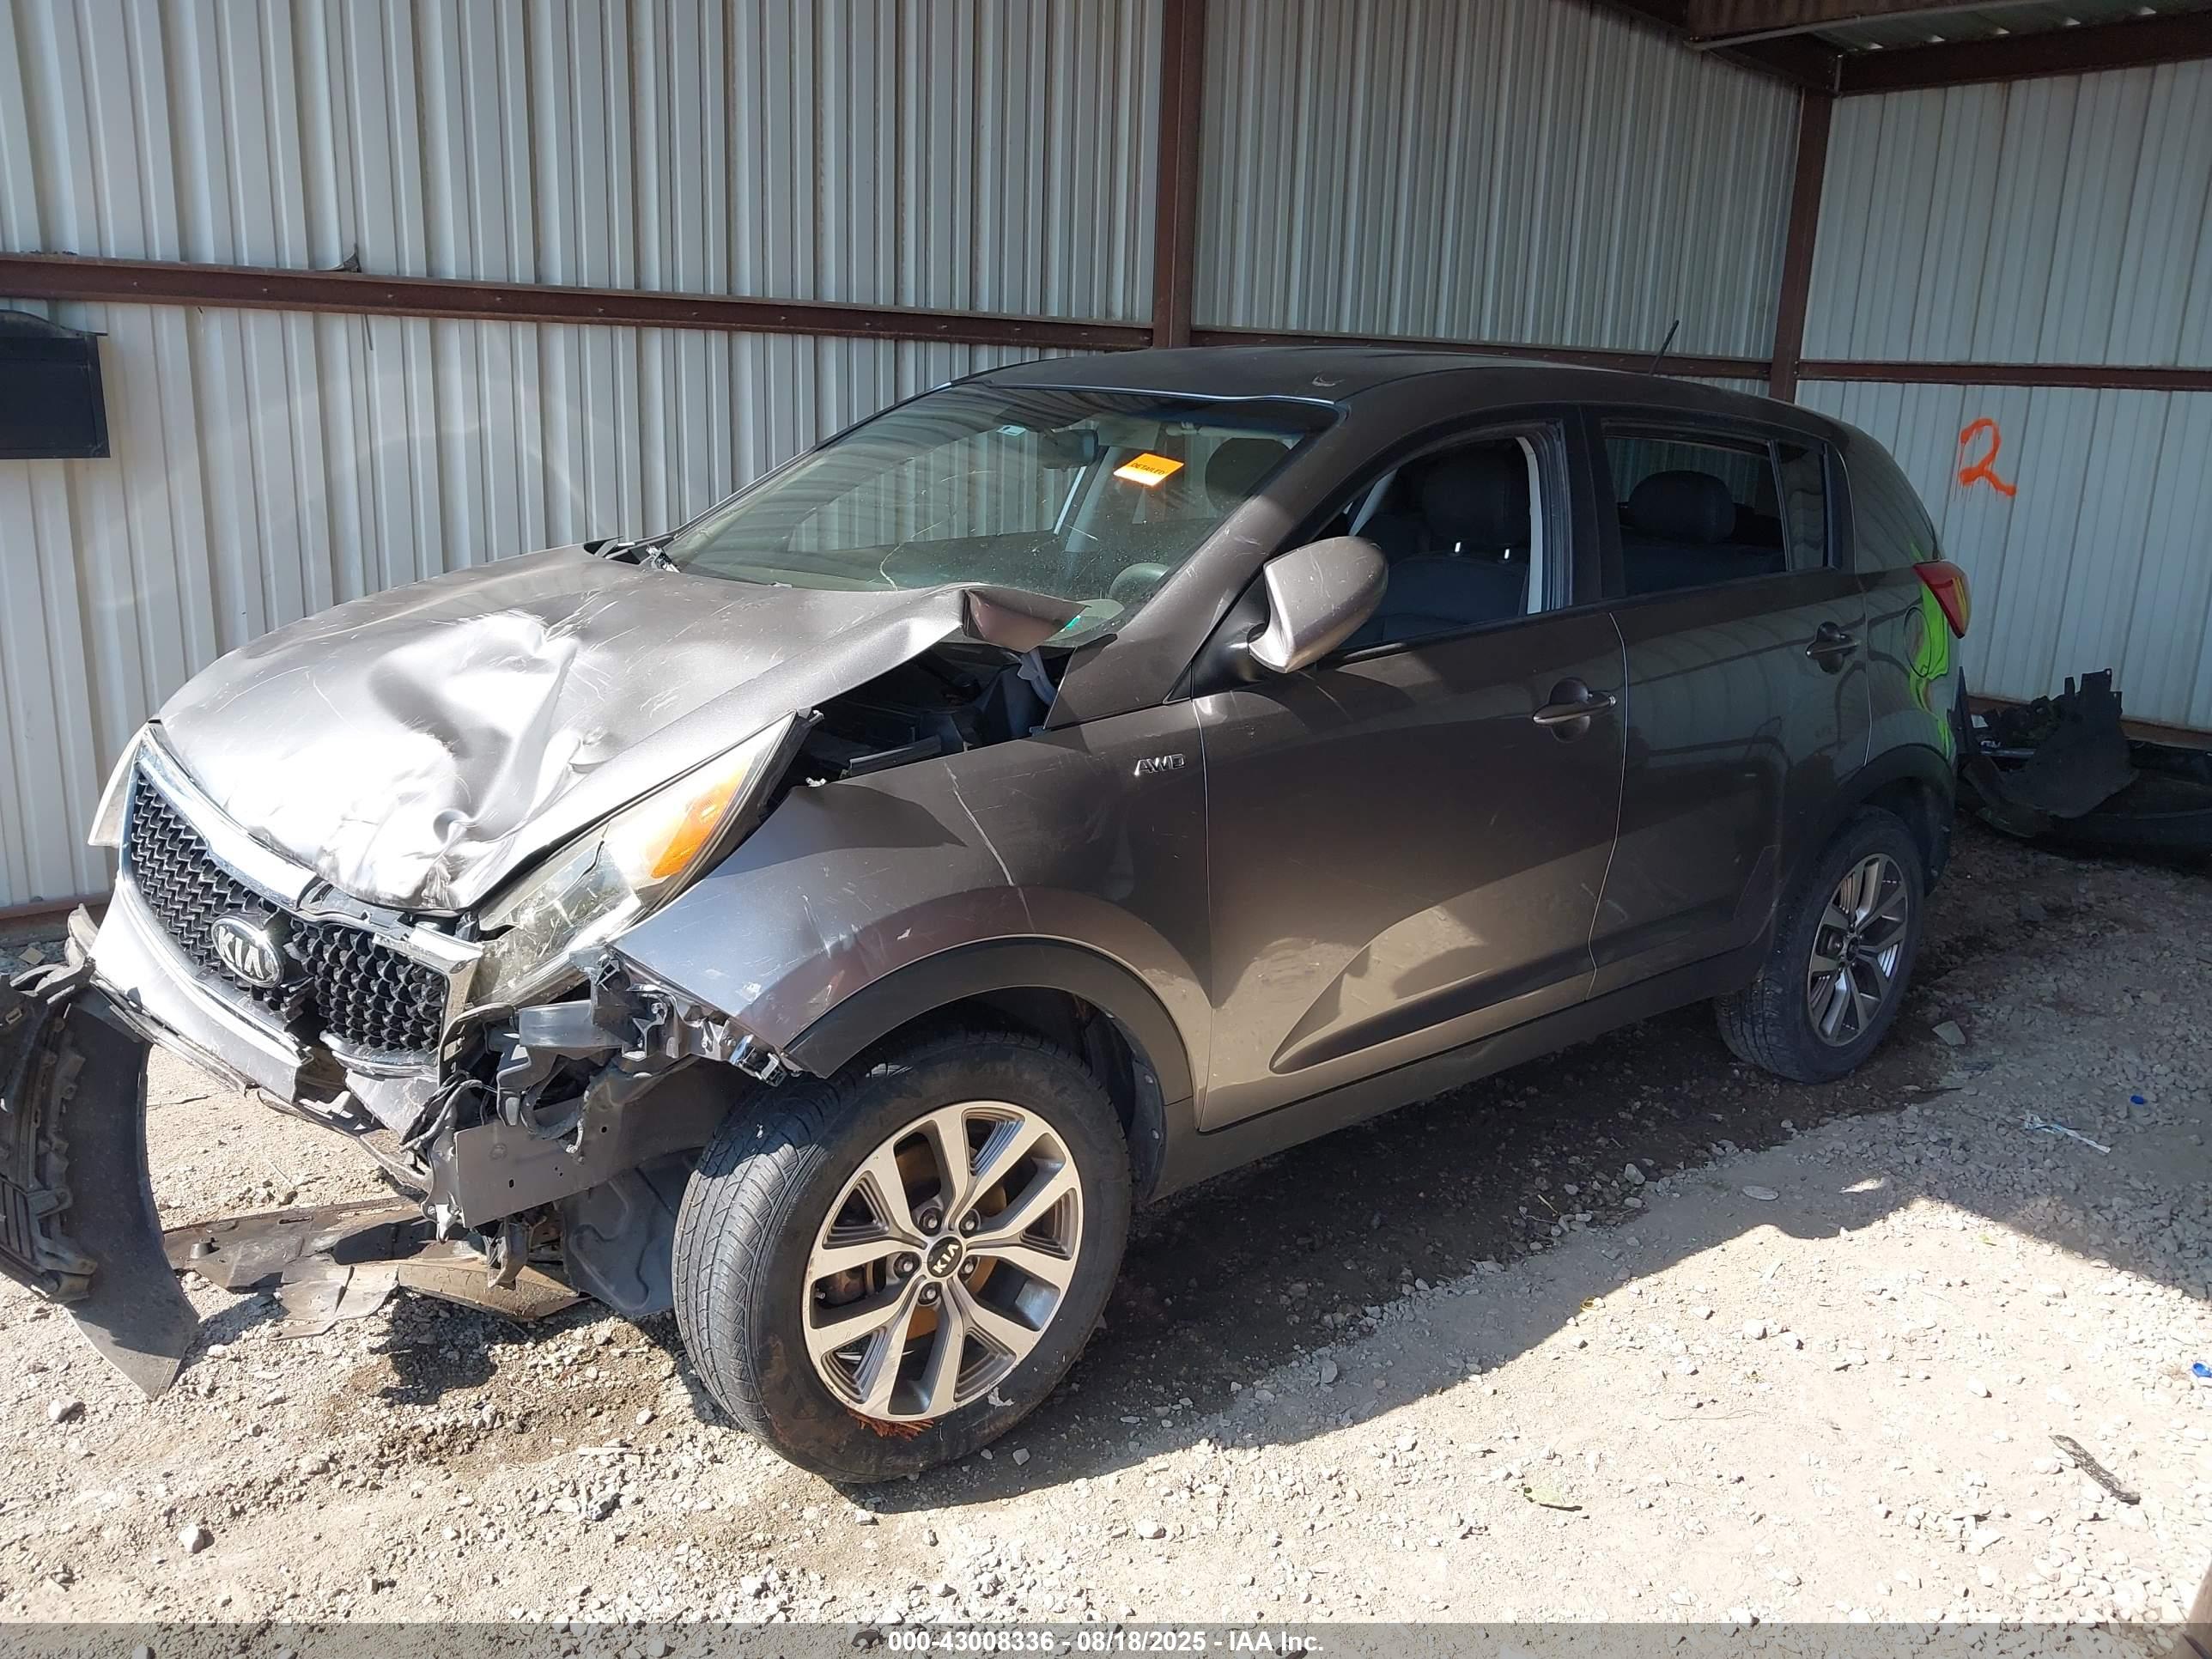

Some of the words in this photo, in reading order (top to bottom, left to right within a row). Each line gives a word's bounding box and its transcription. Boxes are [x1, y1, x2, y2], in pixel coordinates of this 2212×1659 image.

[1960, 417, 2016, 497] 2
[1133, 753, 1185, 776] AWD
[218, 926, 264, 980] KIA
[933, 1243, 960, 1274] KIA
